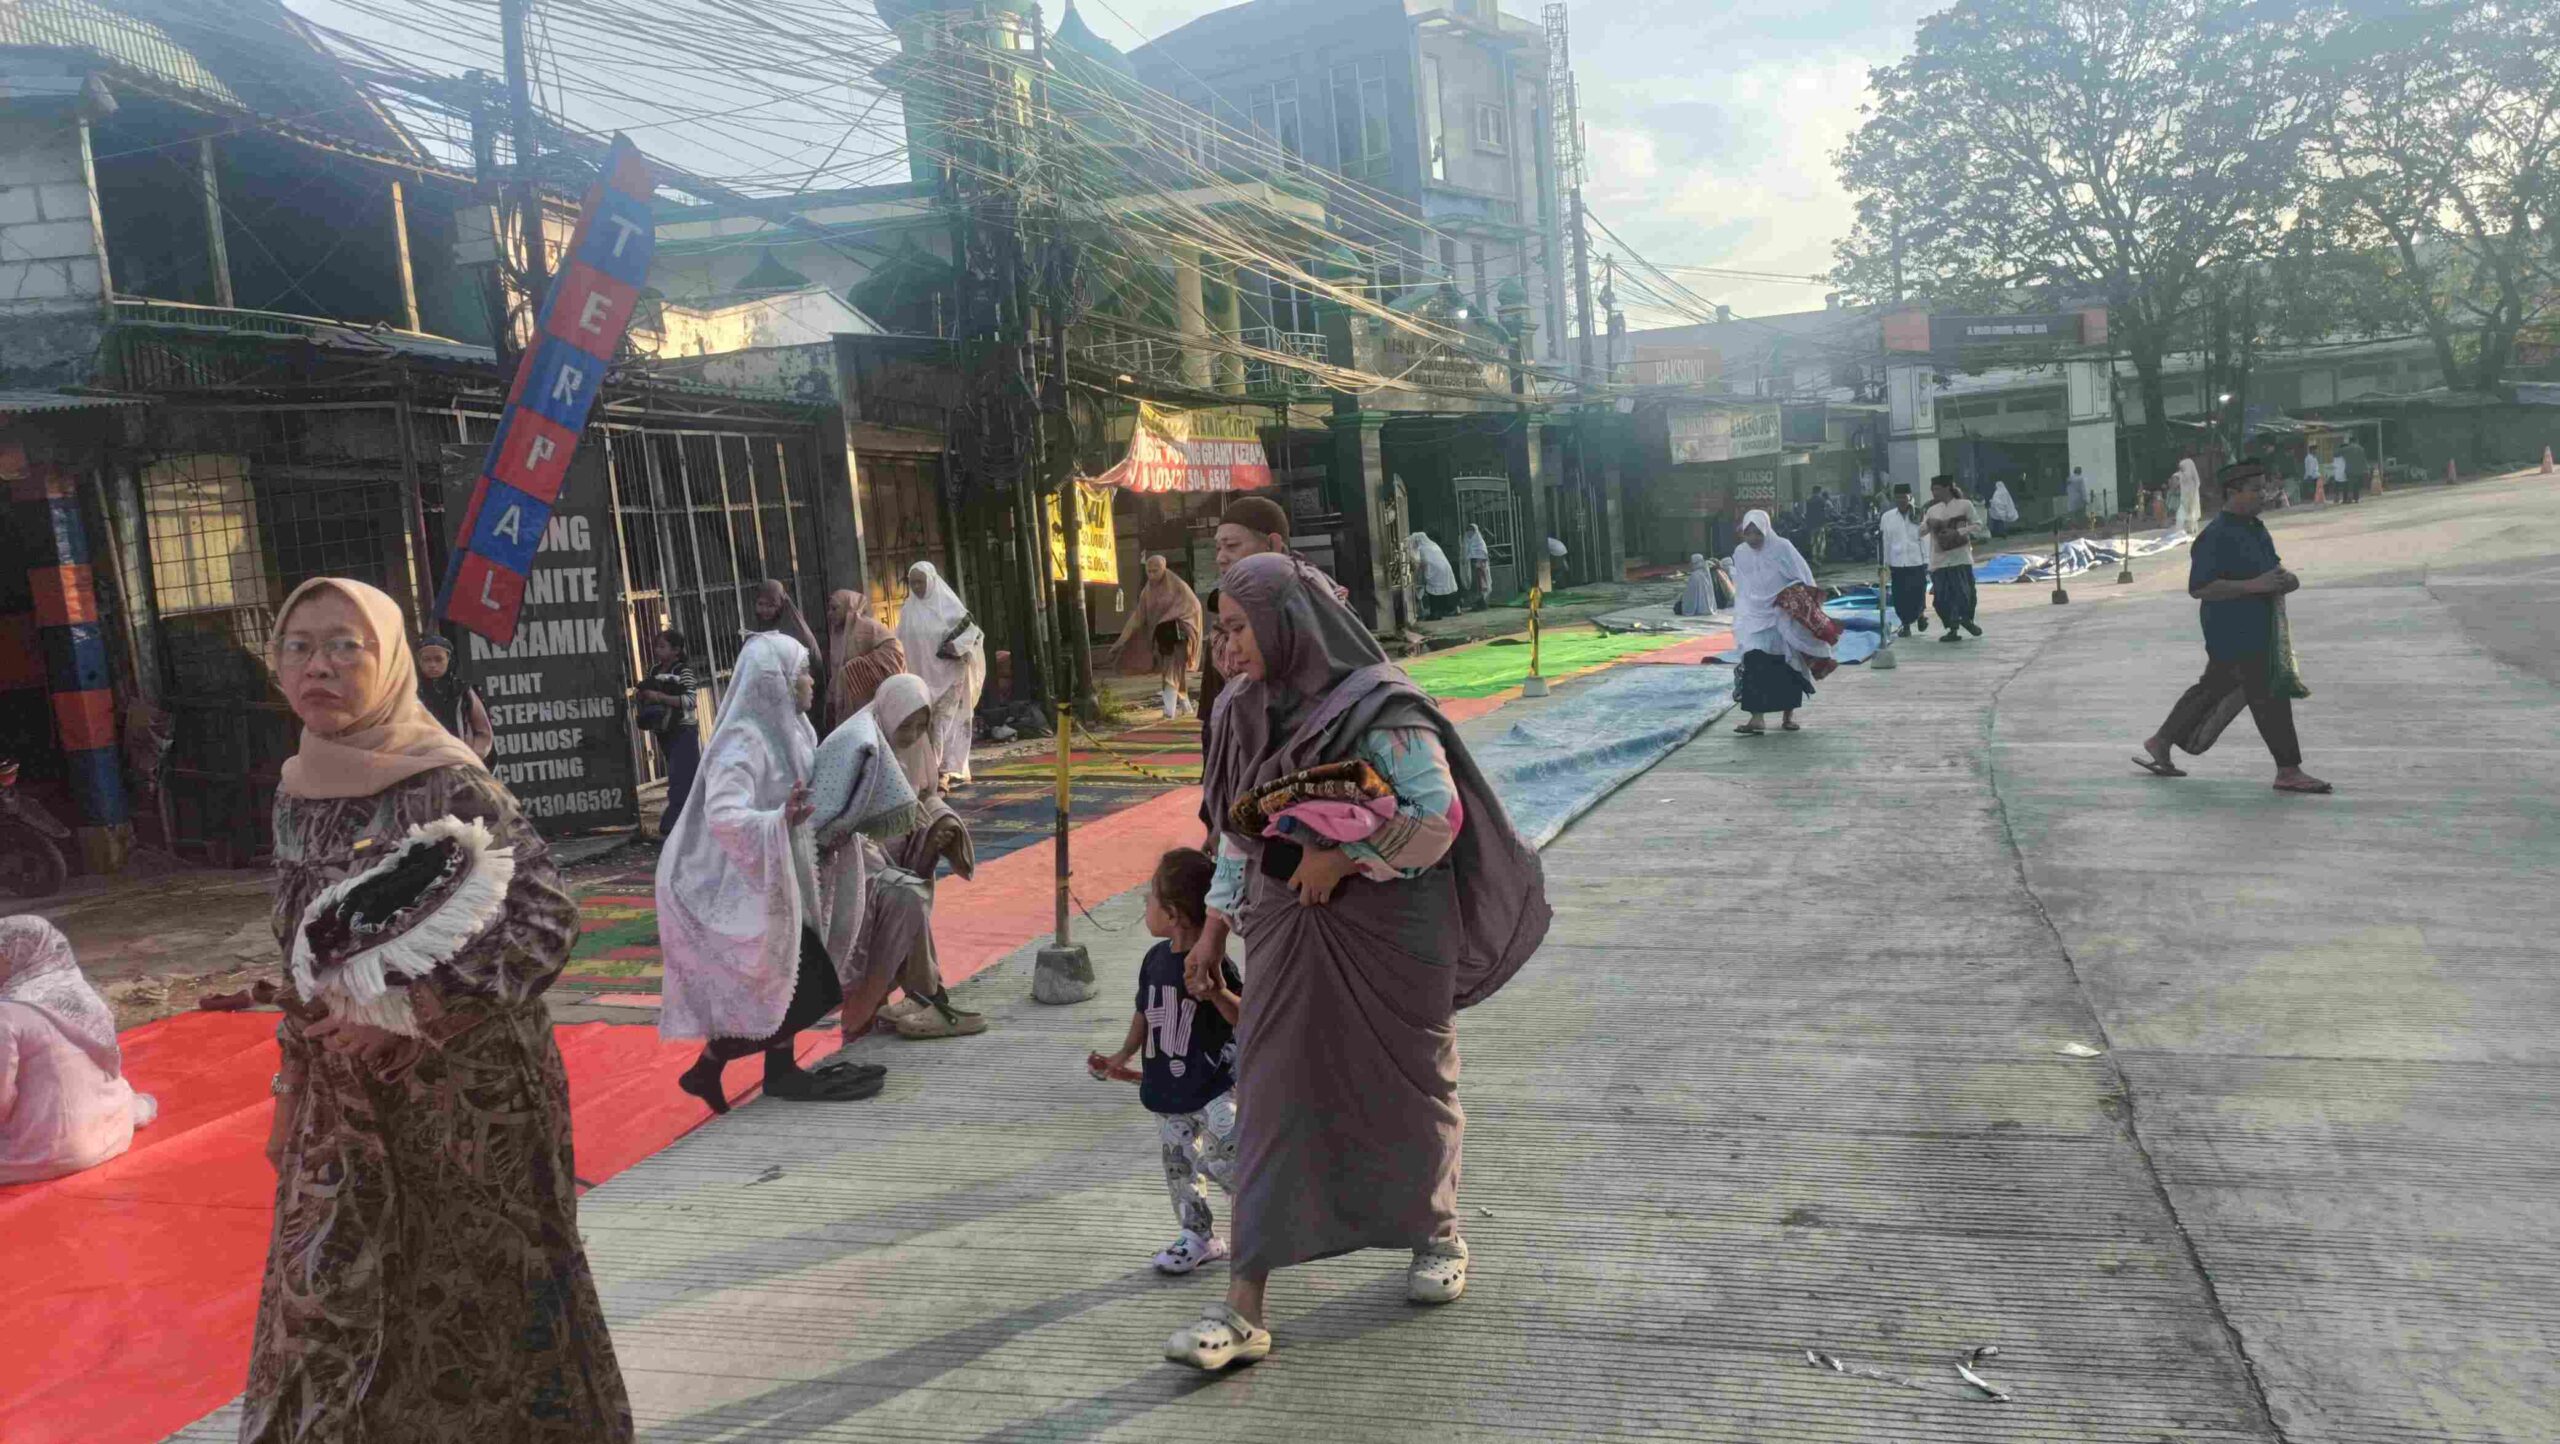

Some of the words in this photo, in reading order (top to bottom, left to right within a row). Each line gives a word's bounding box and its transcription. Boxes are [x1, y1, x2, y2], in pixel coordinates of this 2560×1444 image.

[481, 213, 643, 610] TERPAL
[485, 672, 543, 697] PLINT
[489, 696, 615, 727] STEPNOSING
[494, 728, 583, 756] BULNOSE
[497, 757, 584, 784] CUTTING
